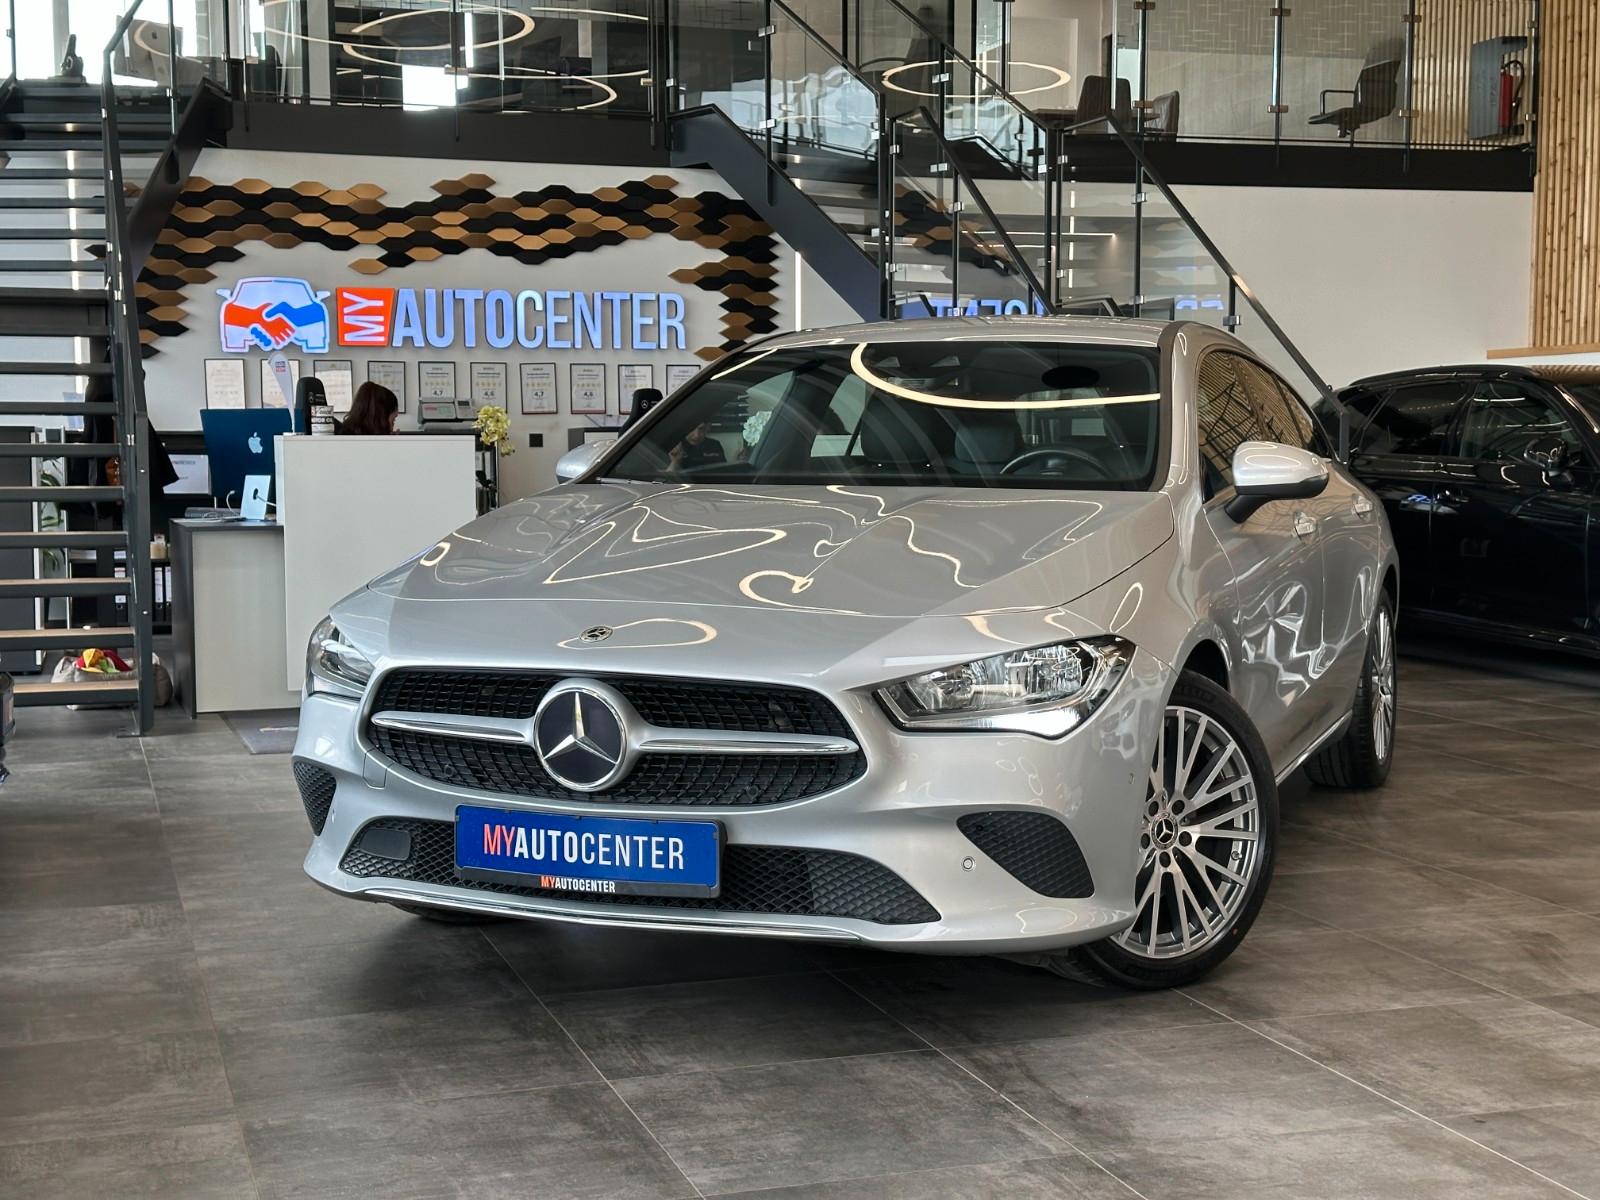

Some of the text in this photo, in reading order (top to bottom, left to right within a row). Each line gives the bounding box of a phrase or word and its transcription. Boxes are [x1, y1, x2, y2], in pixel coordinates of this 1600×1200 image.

[343, 288, 687, 350] MY AUTOCENTER
[483, 823, 685, 870] MYAUTOCENTER
[540, 875, 616, 893] MYAUTOCENTER
